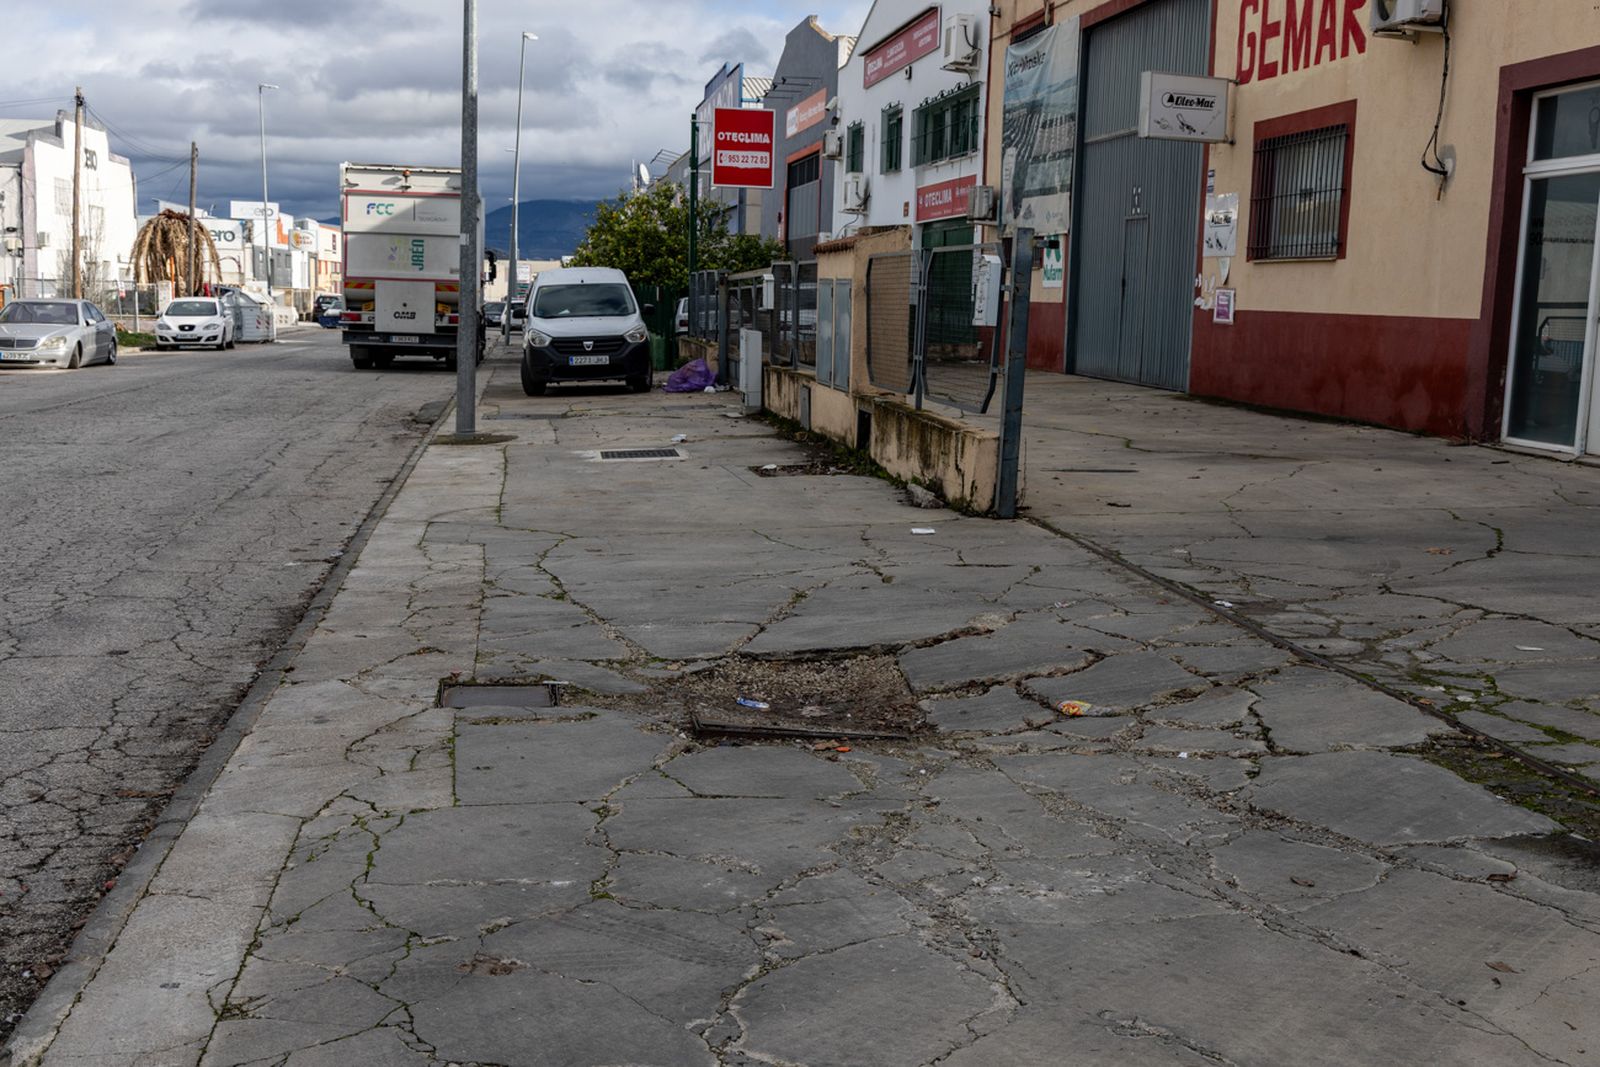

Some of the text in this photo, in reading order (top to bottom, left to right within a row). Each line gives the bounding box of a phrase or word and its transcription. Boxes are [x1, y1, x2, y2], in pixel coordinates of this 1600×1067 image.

[1236, 0, 1366, 86] GEMAR
[717, 132, 770, 144] OTECLIMA
[727, 154, 768, 165] 953 22 72 83
[367, 203, 395, 215] FCC
